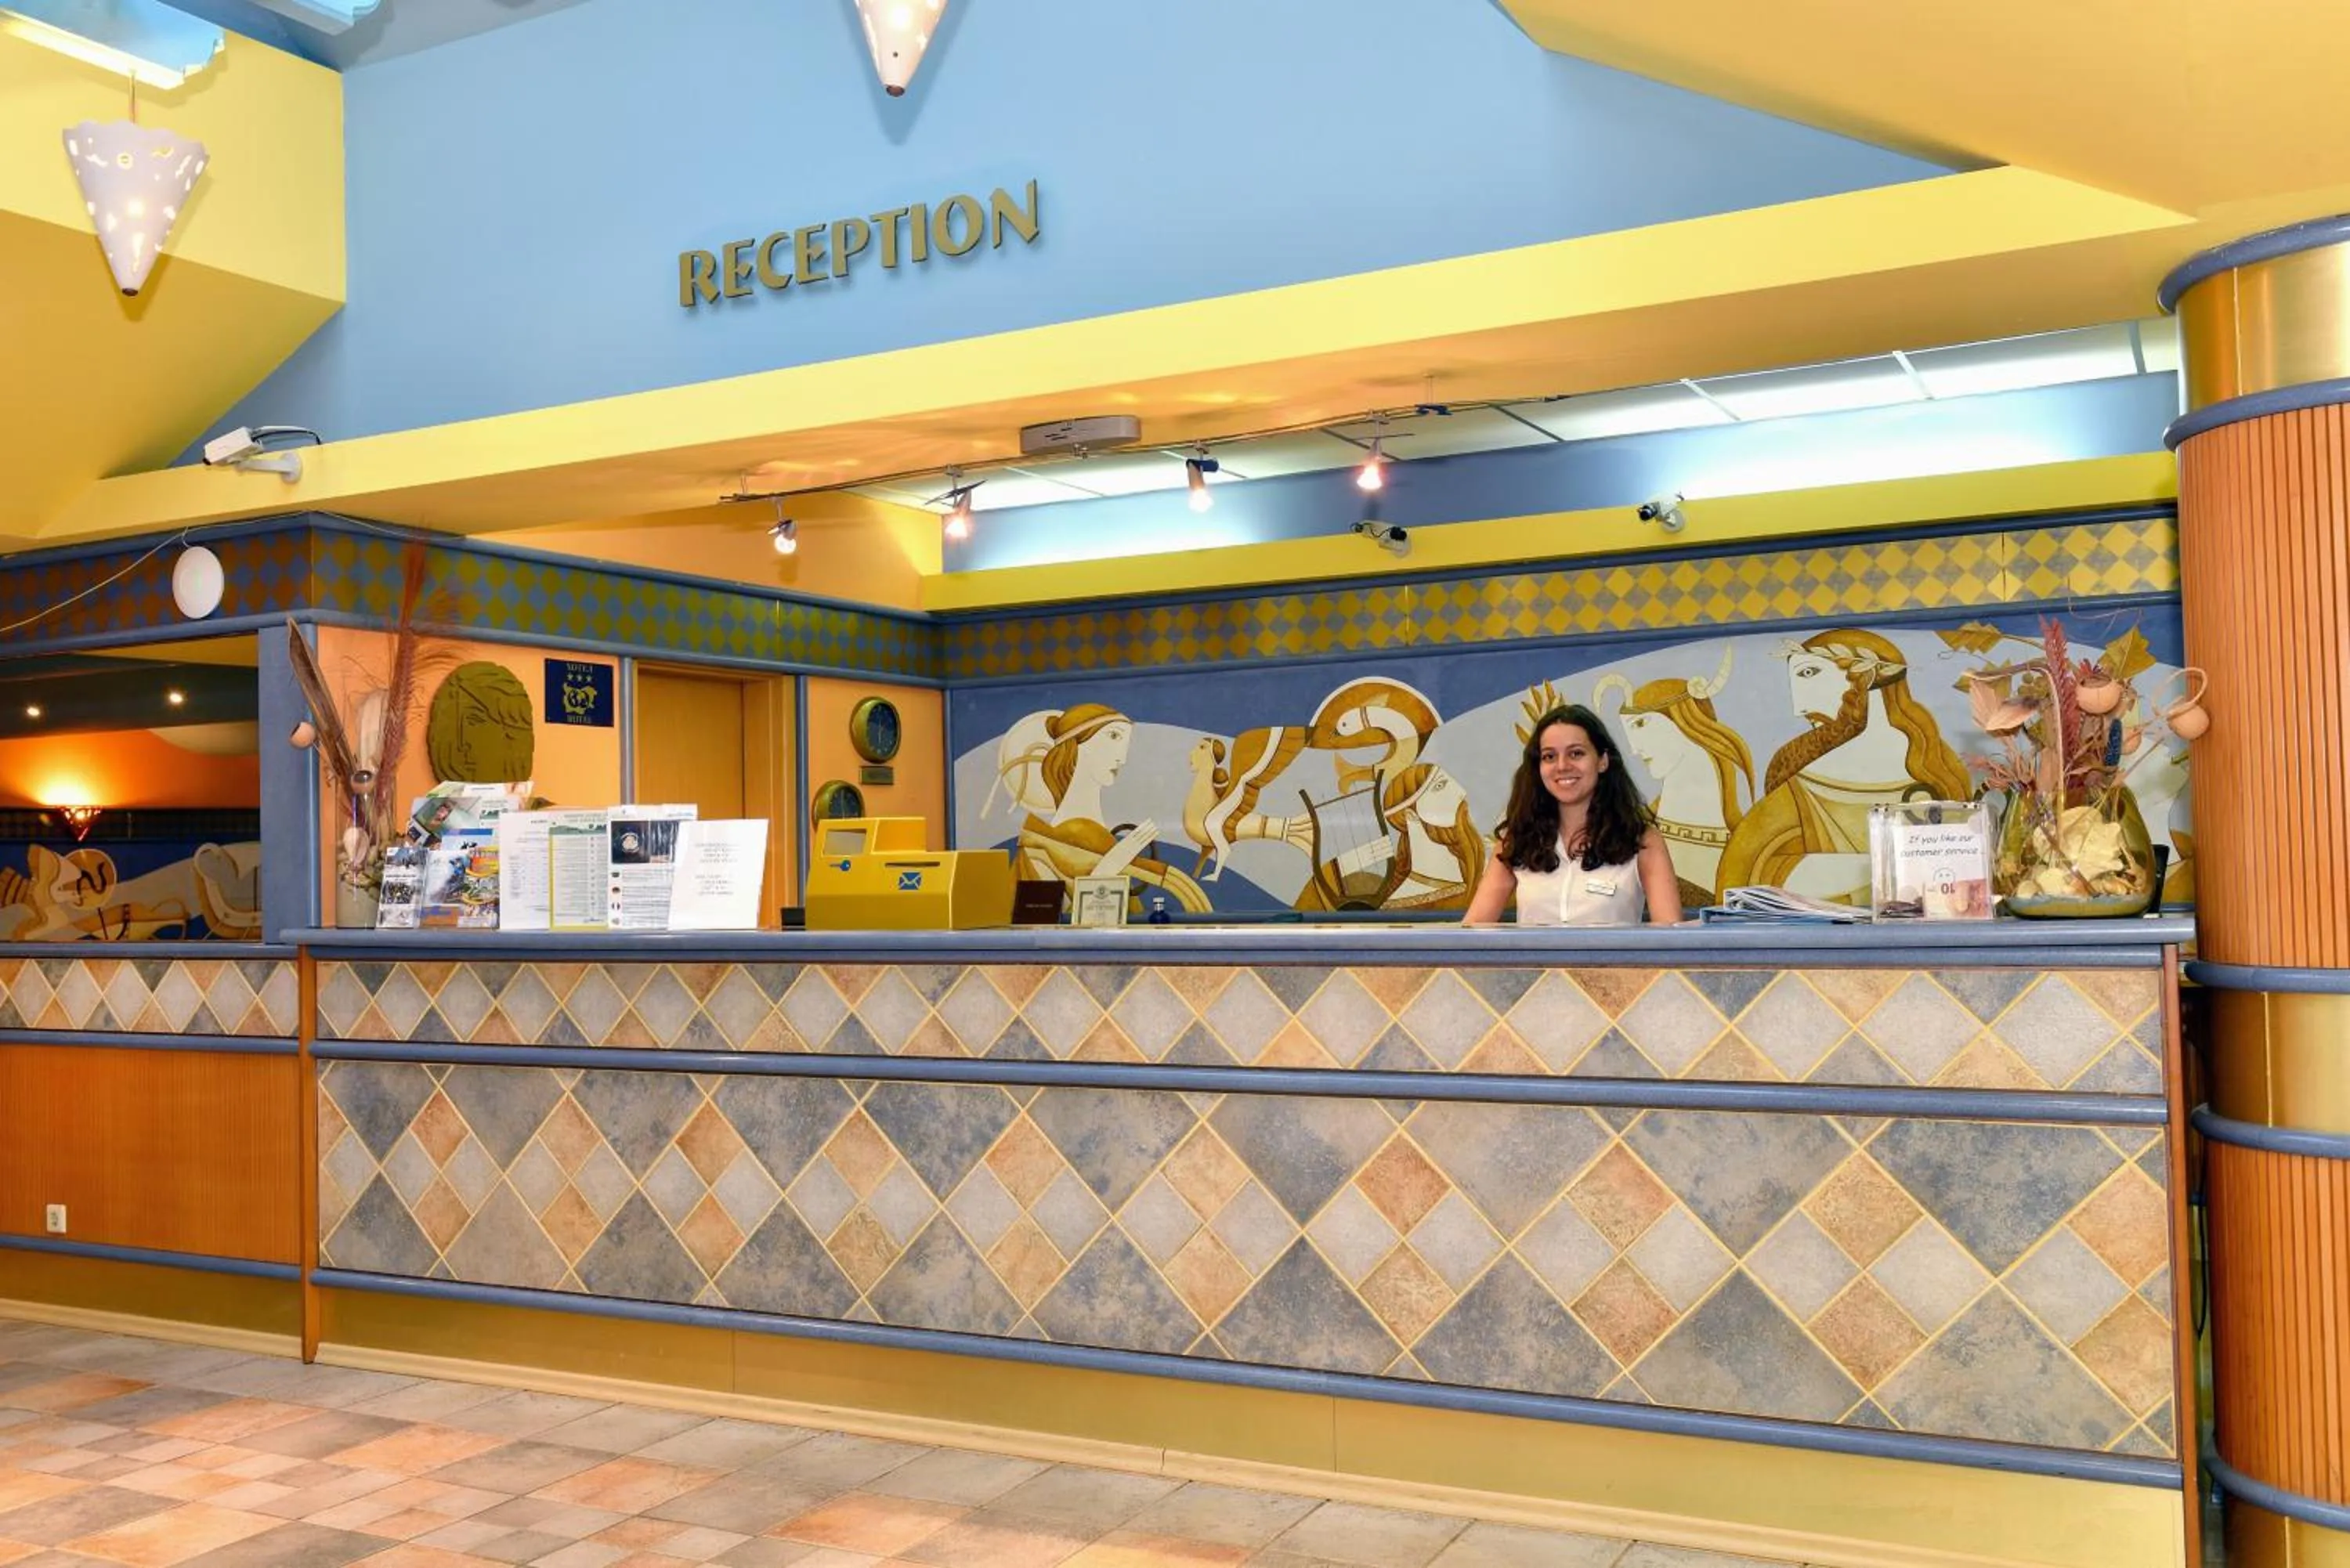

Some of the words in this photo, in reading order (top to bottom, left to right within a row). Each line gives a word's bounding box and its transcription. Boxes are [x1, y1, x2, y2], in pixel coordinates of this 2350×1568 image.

[678, 179, 1039, 308] RECEPTION
[1921, 836, 1939, 844] you
[1900, 848, 1943, 858] customer
